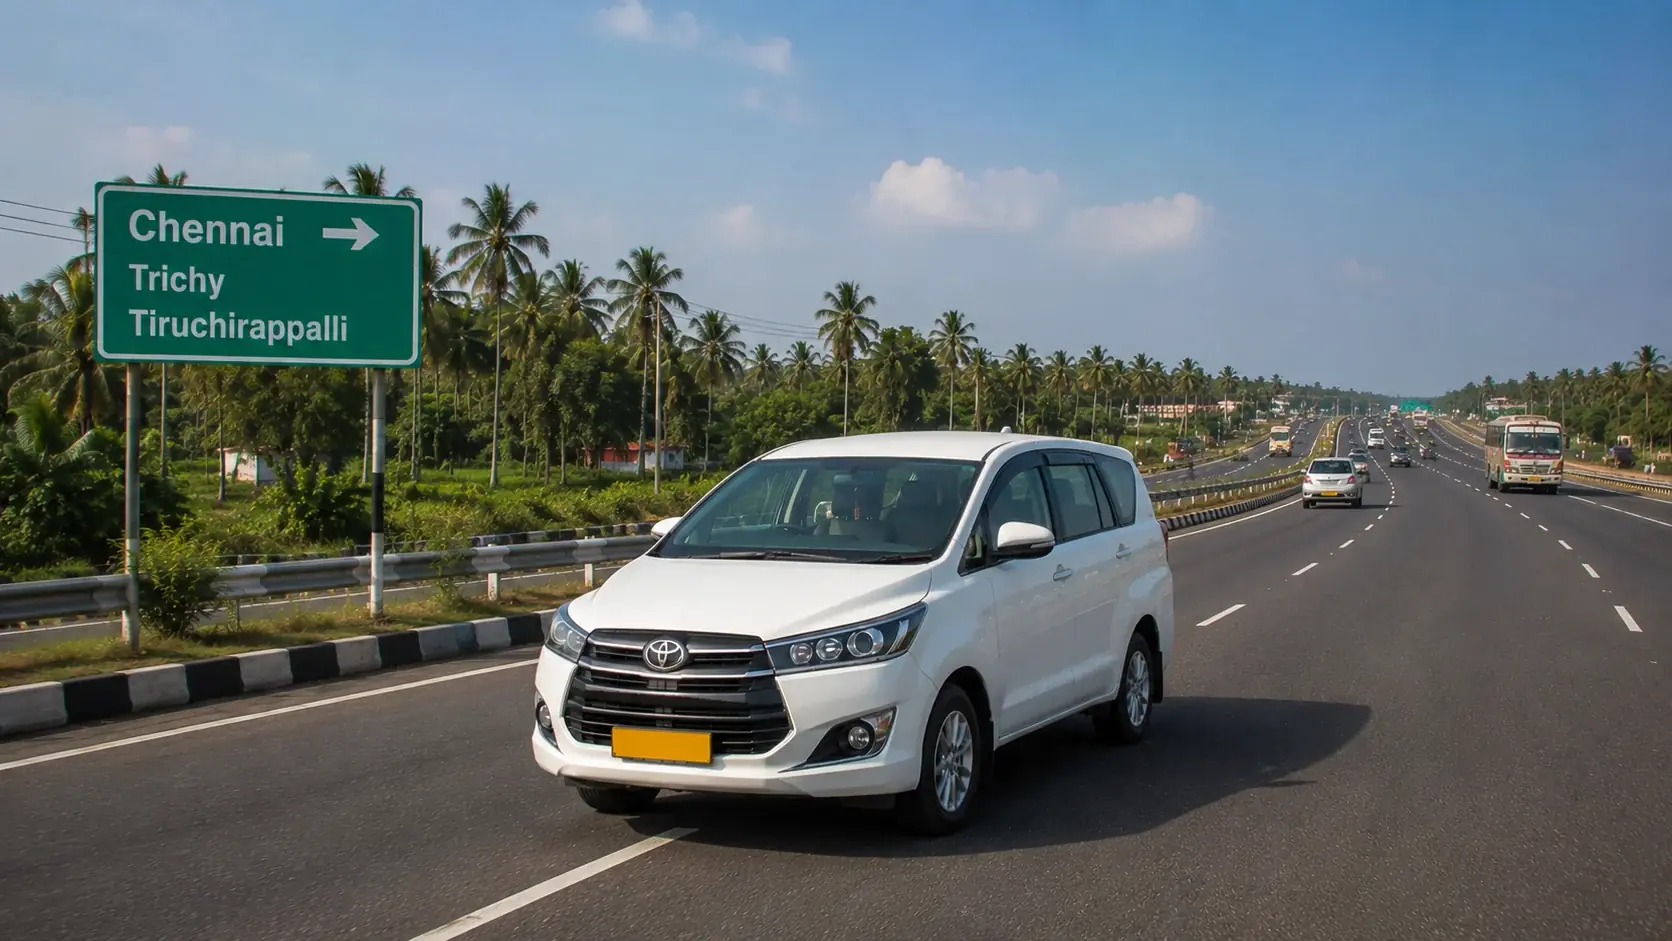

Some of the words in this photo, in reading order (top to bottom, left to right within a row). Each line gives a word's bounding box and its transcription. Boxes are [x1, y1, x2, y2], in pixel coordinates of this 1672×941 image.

[129, 208, 284, 247] Chennai
[128, 263, 225, 300] Trichy
[128, 308, 348, 346] Tiruchirappalli
